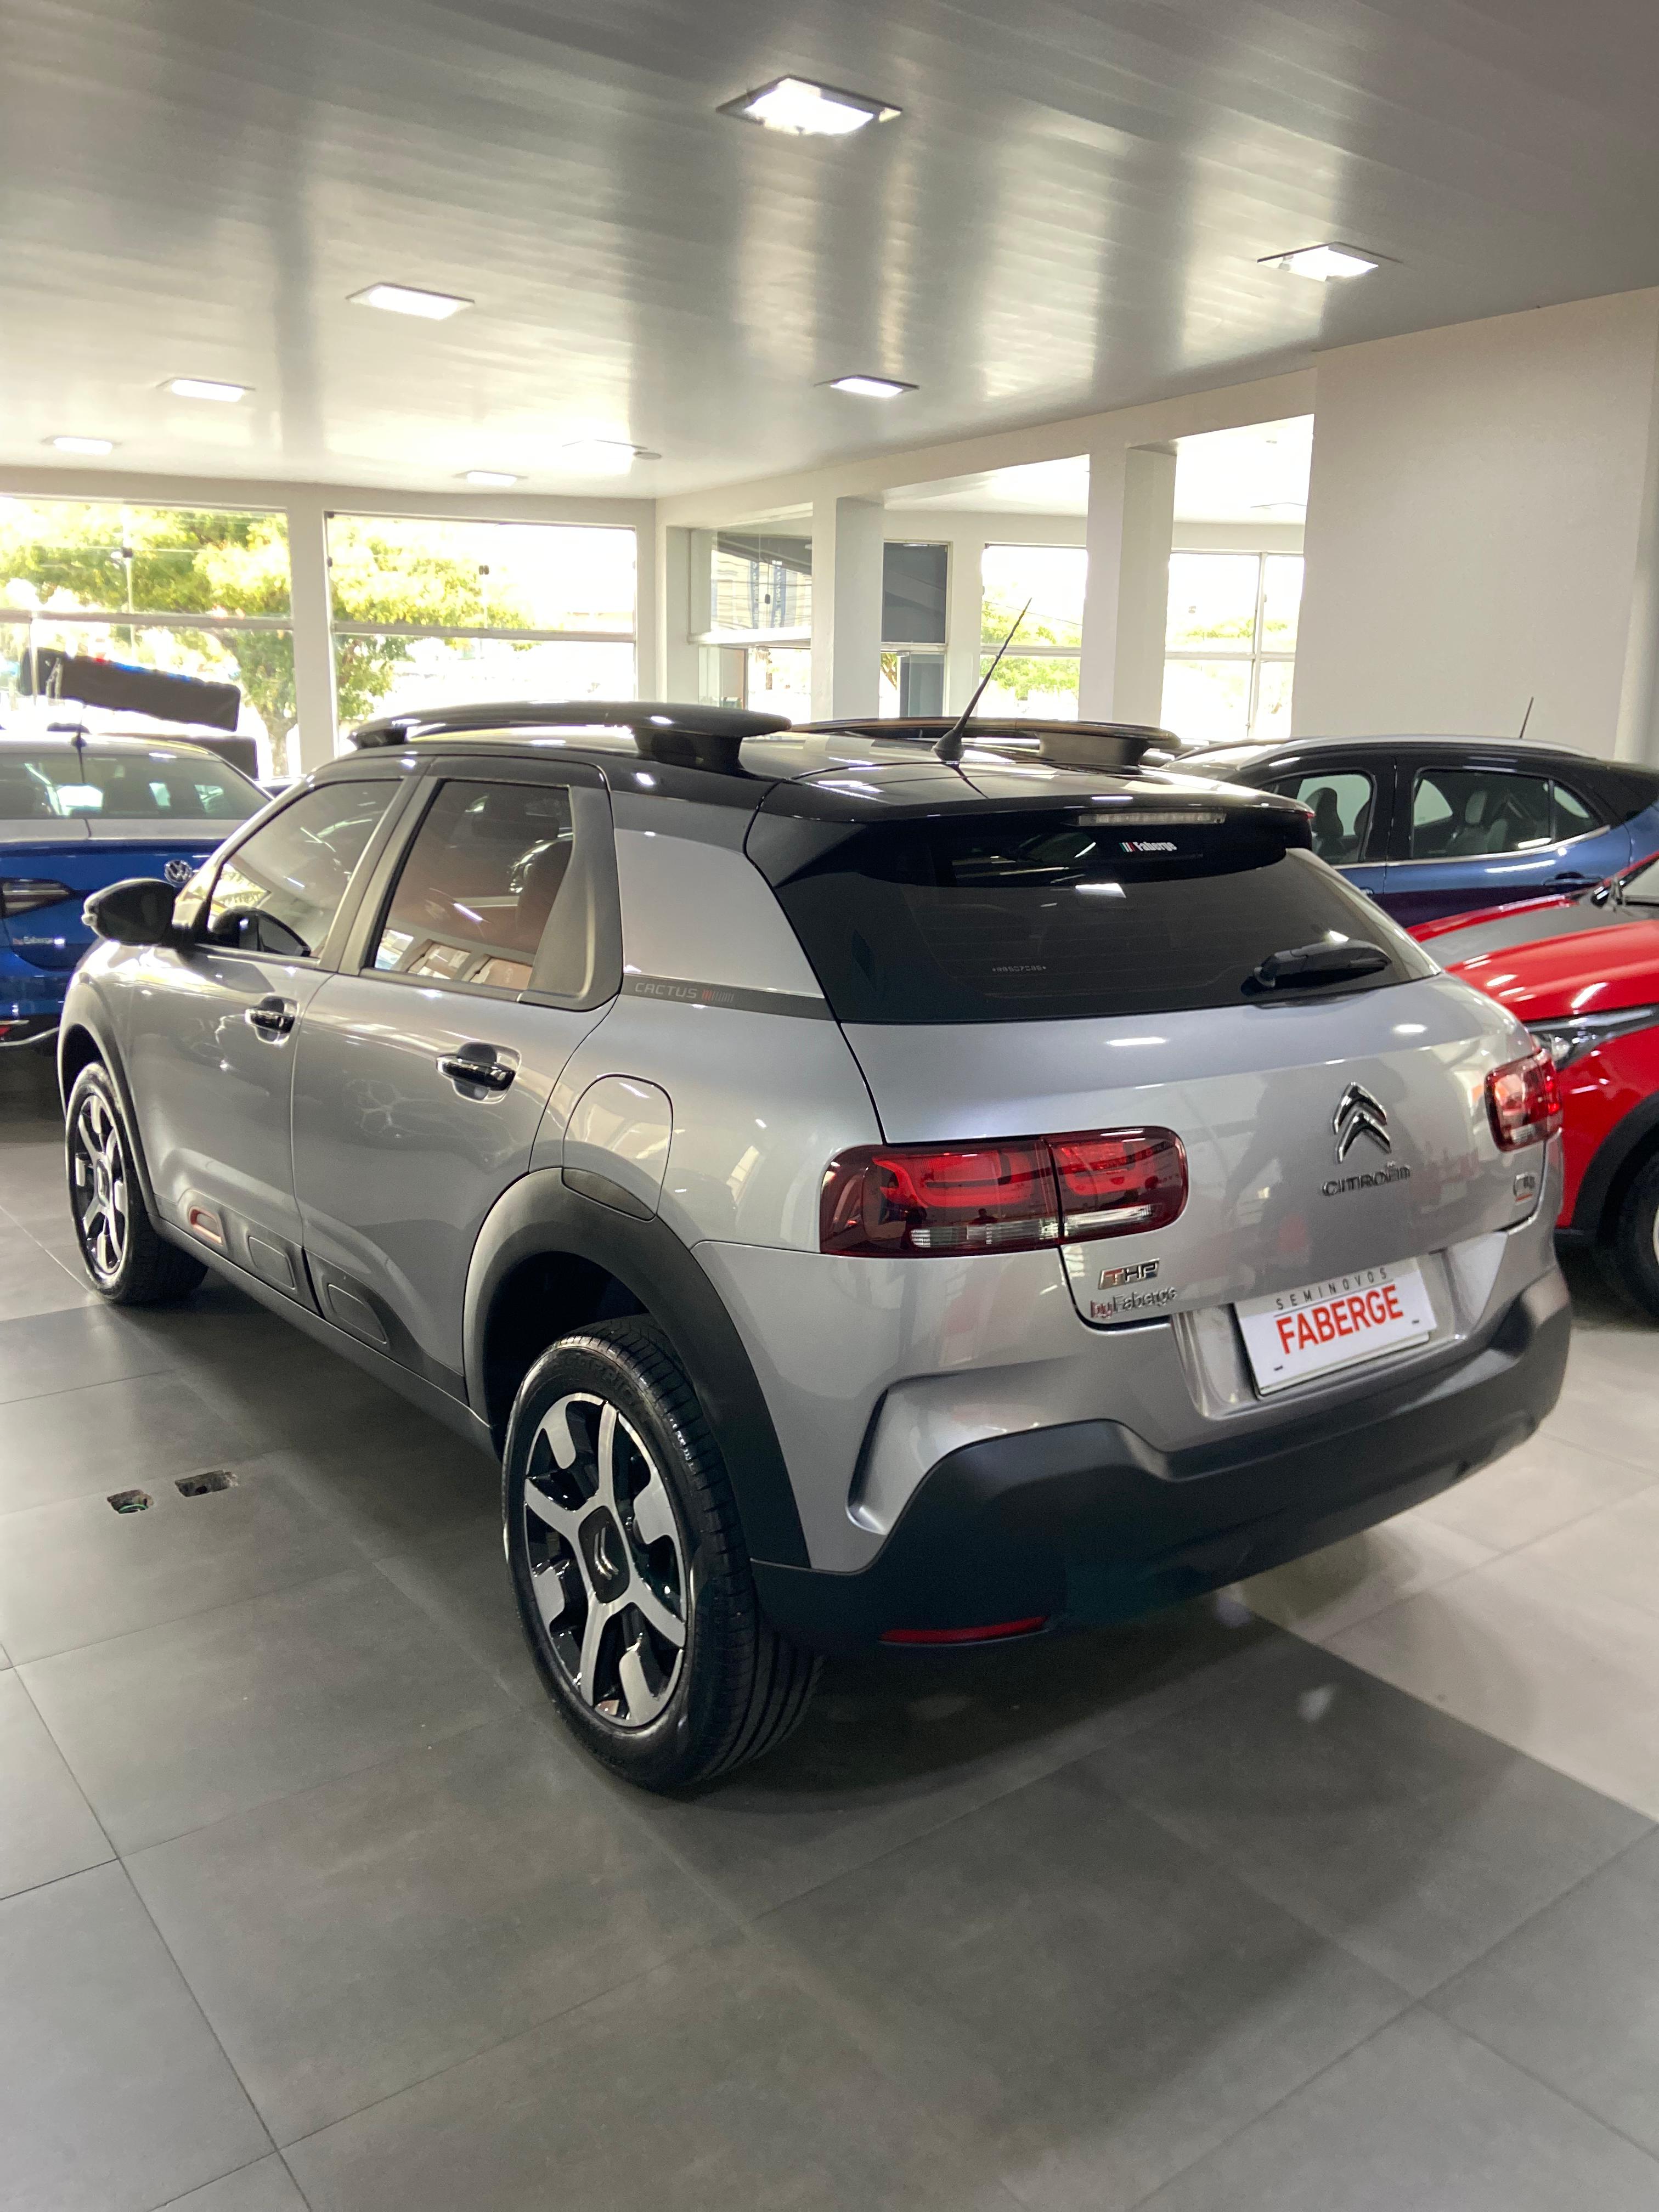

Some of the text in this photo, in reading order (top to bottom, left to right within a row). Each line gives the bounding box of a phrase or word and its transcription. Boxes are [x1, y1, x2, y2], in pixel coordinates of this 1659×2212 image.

[635, 982, 698, 998] CACTUS
[1102, 1261, 1159, 1285] THP
[1276, 1268, 1387, 1310] SEMINOVOS
[1276, 1284, 1404, 1355] FABERGE
